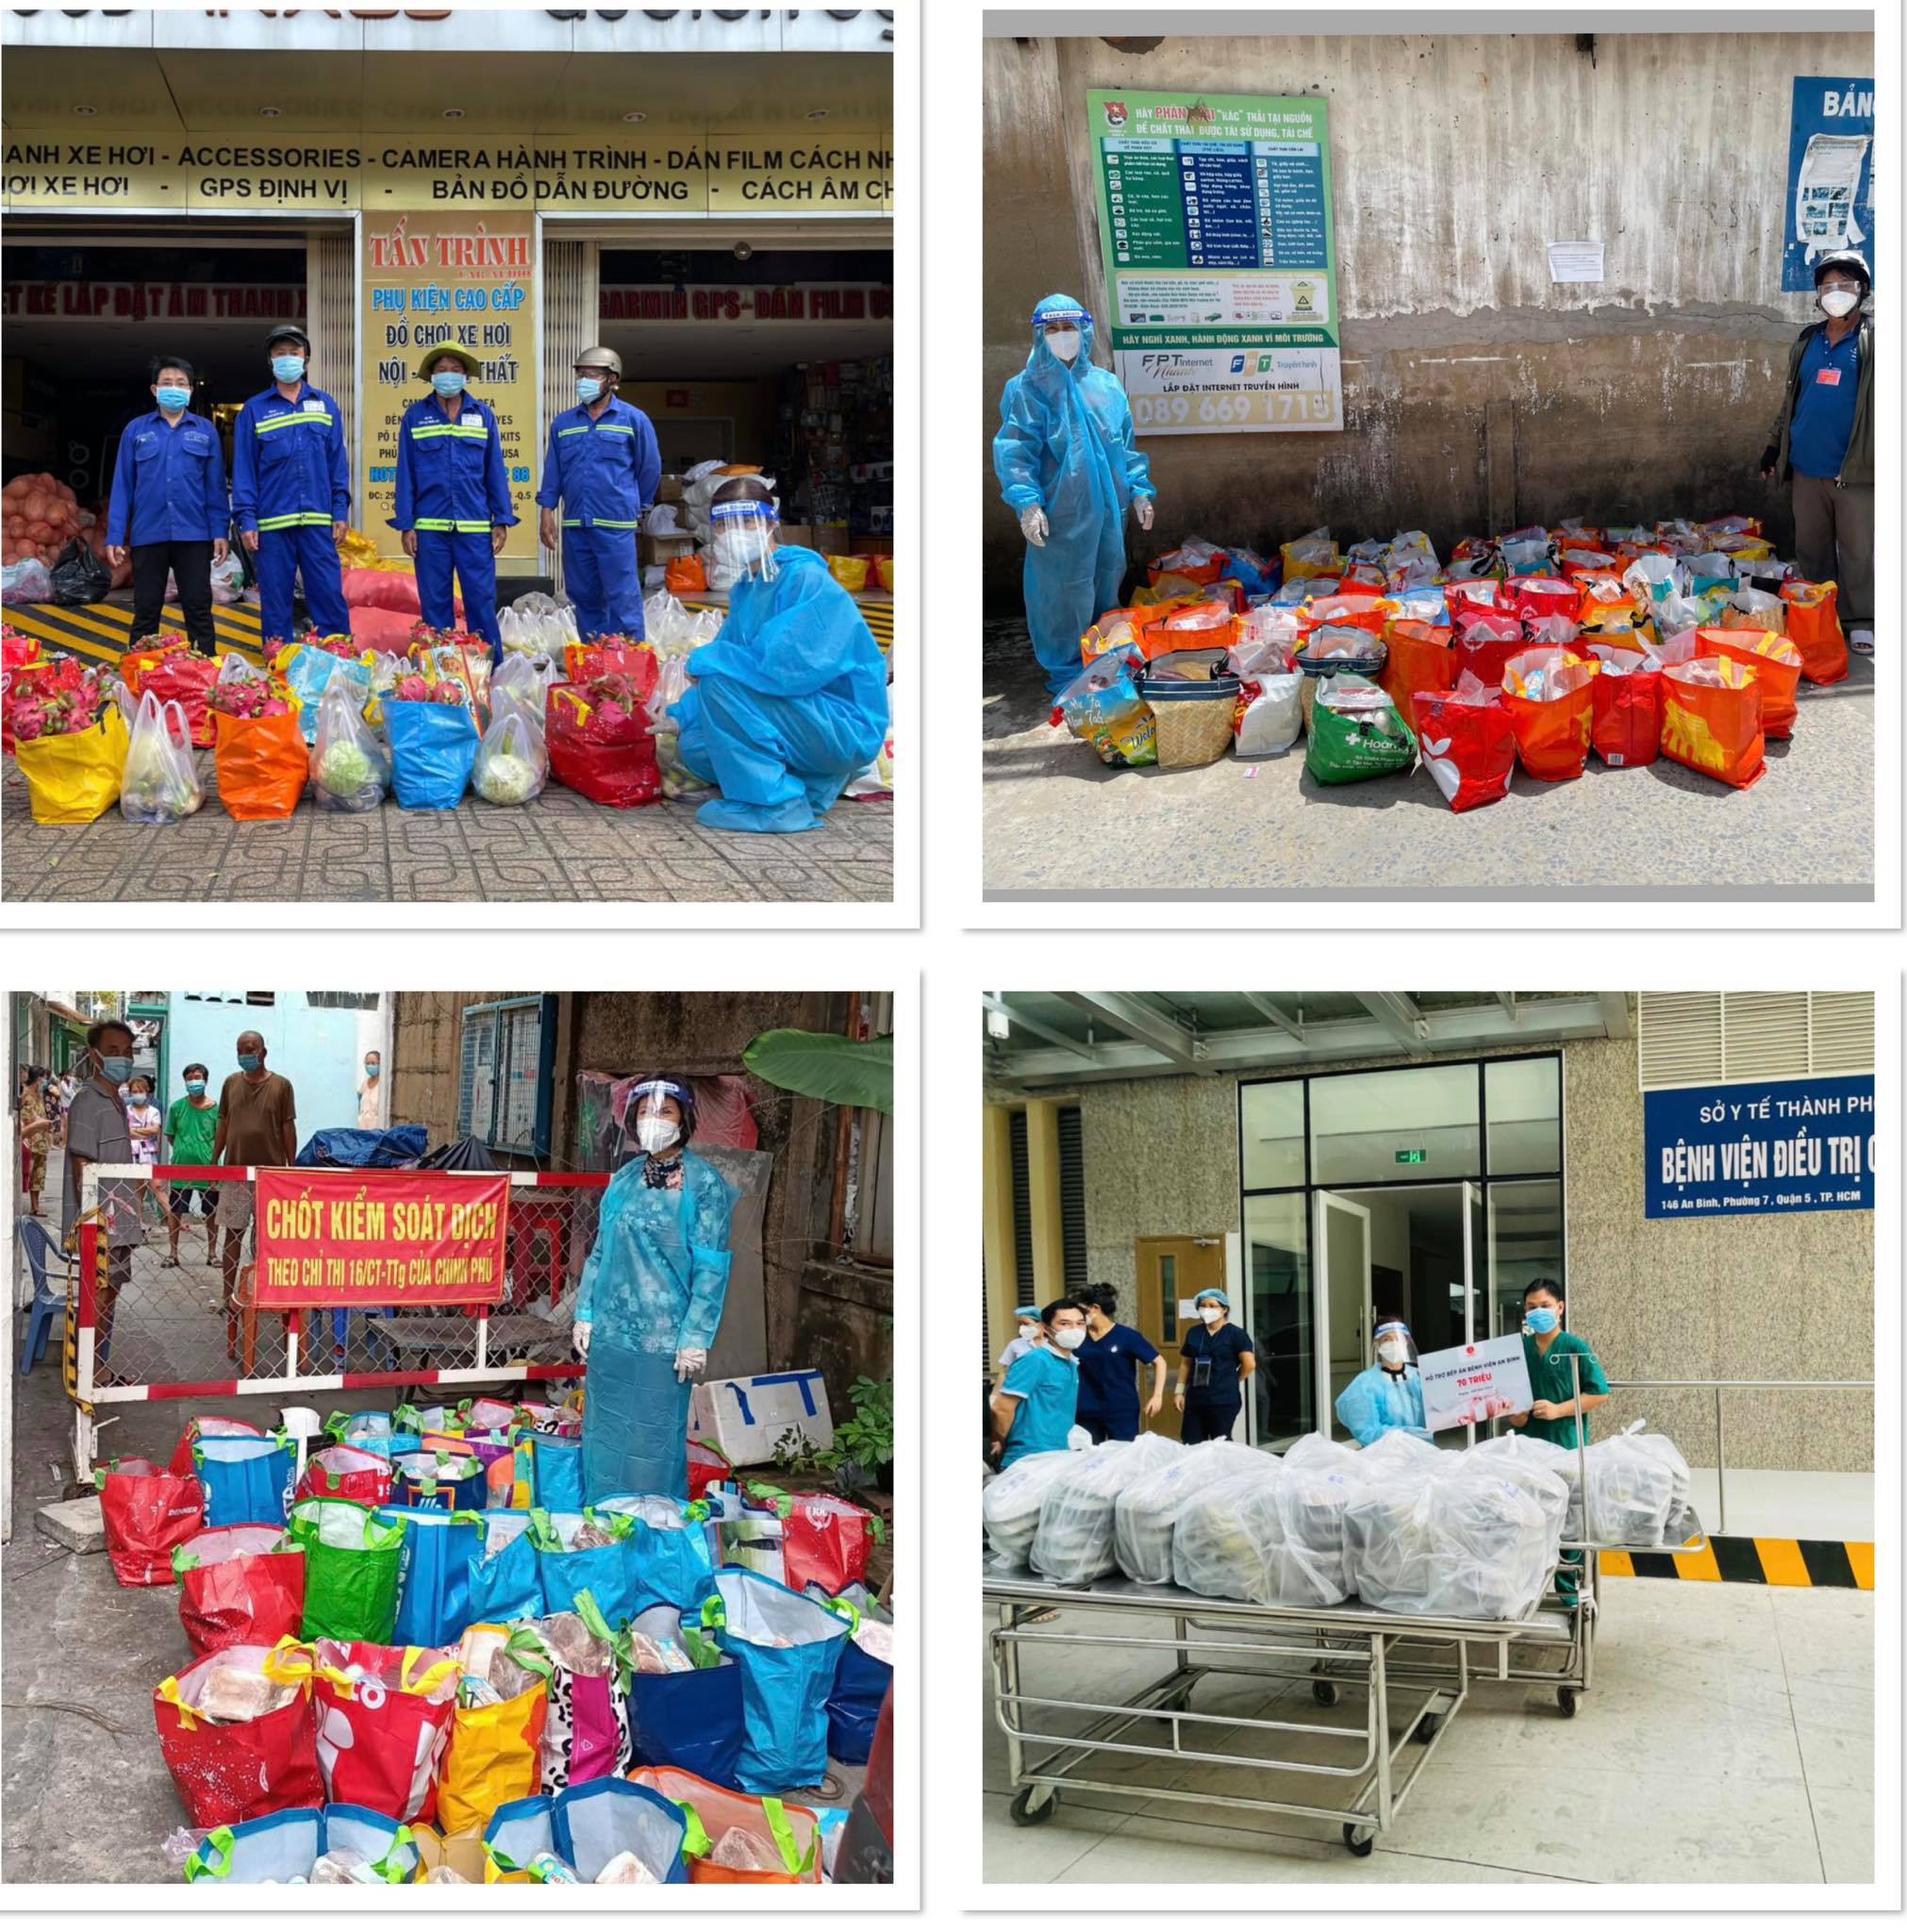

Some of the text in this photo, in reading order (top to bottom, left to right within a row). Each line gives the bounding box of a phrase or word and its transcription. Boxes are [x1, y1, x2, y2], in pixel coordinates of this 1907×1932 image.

[1823, 83, 1874, 117] BẢN
[2, 145, 59, 164] ANH
[68, 145, 101, 164] XE
[109, 146, 154, 165] HƠI
[178, 147, 361, 168] ACCESSORIES
[382, 149, 490, 169] CAMERA
[498, 144, 566, 169] HÀNH
[573, 144, 646, 169] TRÌNH
[668, 145, 720, 170] DÁN
[727, 150, 783, 170] FILM
[789, 144, 860, 169] CÁCH
[2, 175, 36, 195] ƠI
[44, 175, 77, 195] XE
[84, 176, 128, 195] HƠI
[200, 177, 251, 197] GPS
[258, 179, 317, 204] ĐỊNH
[324, 179, 347, 204] VỊ
[433, 174, 485, 199] BẢN
[491, 173, 527, 199] ĐỒ
[535, 172, 587, 199] DẪN
[593, 175, 688, 199] ĐƯỜNG
[742, 175, 812, 199] CÁCH
[821, 176, 858, 199] ÂM
[370, 216, 530, 268] TẤN TRÌNH
[2, 285, 23, 315] T
[212, 287, 292, 318] THANH
[373, 279, 525, 314] PHỤ KIỆN CAO CẤP
[599, 289, 688, 319] GARMIN
[692, 289, 741, 319] GPS
[809, 289, 866, 319] FILM
[386, 314, 512, 347] ĐỒ CHƠI XE HƠI
[1241, 334, 1263, 343] XANH
[378, 353, 518, 389] NỘI THẤT
[1141, 354, 1213, 368] FPT Internet
[1202, 383, 1241, 392] INTERNET
[1278, 381, 1300, 391] HÌNH
[497, 415, 513, 425] YES
[1135, 396, 1189, 425] 089
[1199, 394, 1252, 423] 669
[501, 431, 521, 441] KITS
[369, 466, 397, 482] HOT
[512, 467, 530, 482] 88
[385, 491, 395, 499] 29
[1700, 1095, 1874, 1123] SỞ Y TẾ THÀNH PH
[1662, 1138, 1715, 1191] BỆNH
[1720, 1134, 1767, 1188] VIỆN
[1773, 1125, 1821, 1177] ĐIỀU
[1828, 1135, 1861, 1182] TRỊ
[1661, 1199, 1679, 1210] 146
[1681, 1199, 1694, 1208] An
[1776, 1192, 1800, 1207] Quận
[1820, 1191, 1834, 1203] TP.
[1836, 1191, 1861, 1202] HCM
[266, 1185, 498, 1249] CHỐT KIỂM SOÁT DỊCH
[268, 1250, 492, 1293] THEO CHỈ THỊ 16/CT-TTg CỦA CHÍNH PHỦ
[1457, 1377, 1467, 1388] 70
